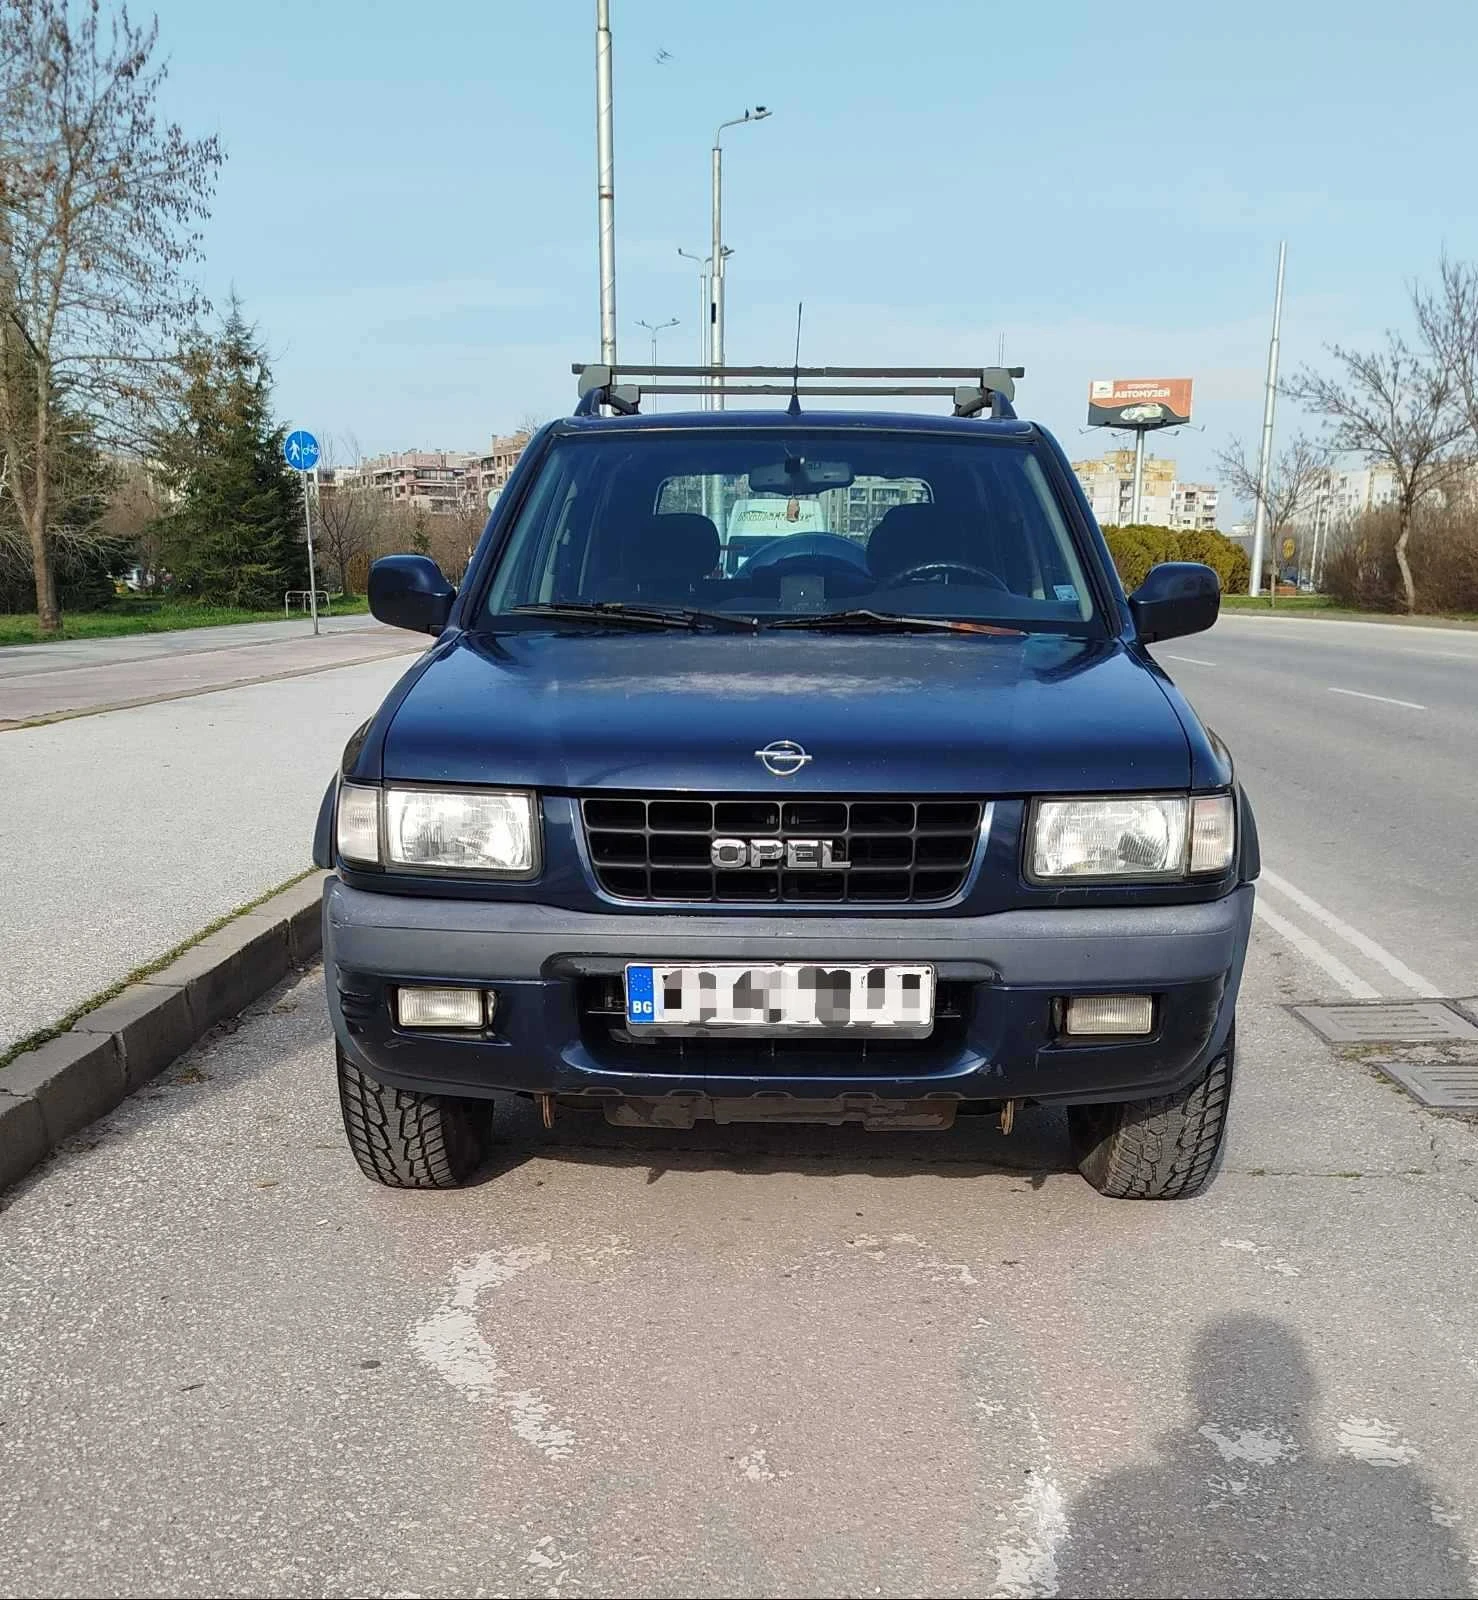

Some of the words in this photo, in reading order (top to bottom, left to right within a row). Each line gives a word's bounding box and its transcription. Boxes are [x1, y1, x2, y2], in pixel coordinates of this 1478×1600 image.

[1114, 387, 1170, 399] АВТОМУЗЕЙ
[711, 838, 851, 868] OPEL
[632, 1000, 653, 1014] BG
